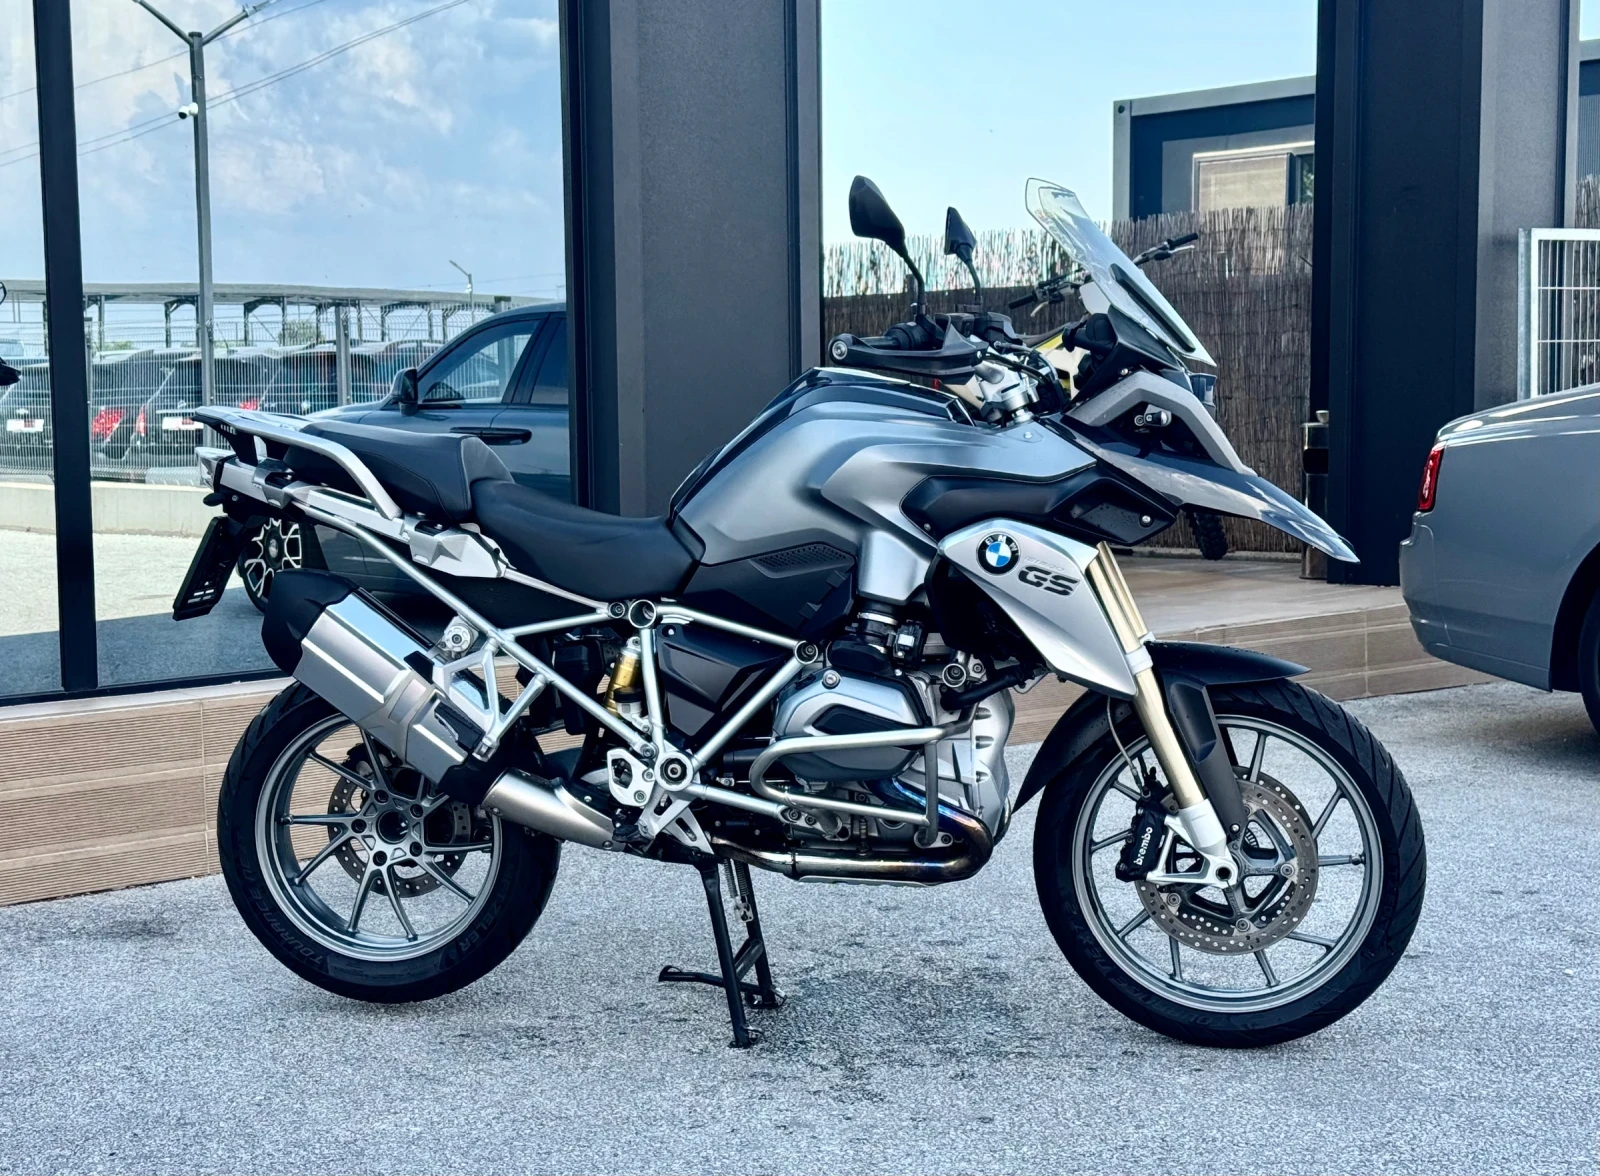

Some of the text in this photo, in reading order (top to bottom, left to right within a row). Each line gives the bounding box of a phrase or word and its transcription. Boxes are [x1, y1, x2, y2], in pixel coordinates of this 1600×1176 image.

[985, 534, 1019, 553] BMW
[1018, 566, 1079, 596] GS
[1133, 827, 1153, 866] brembo
[249, 887, 324, 965] TOURANCE
